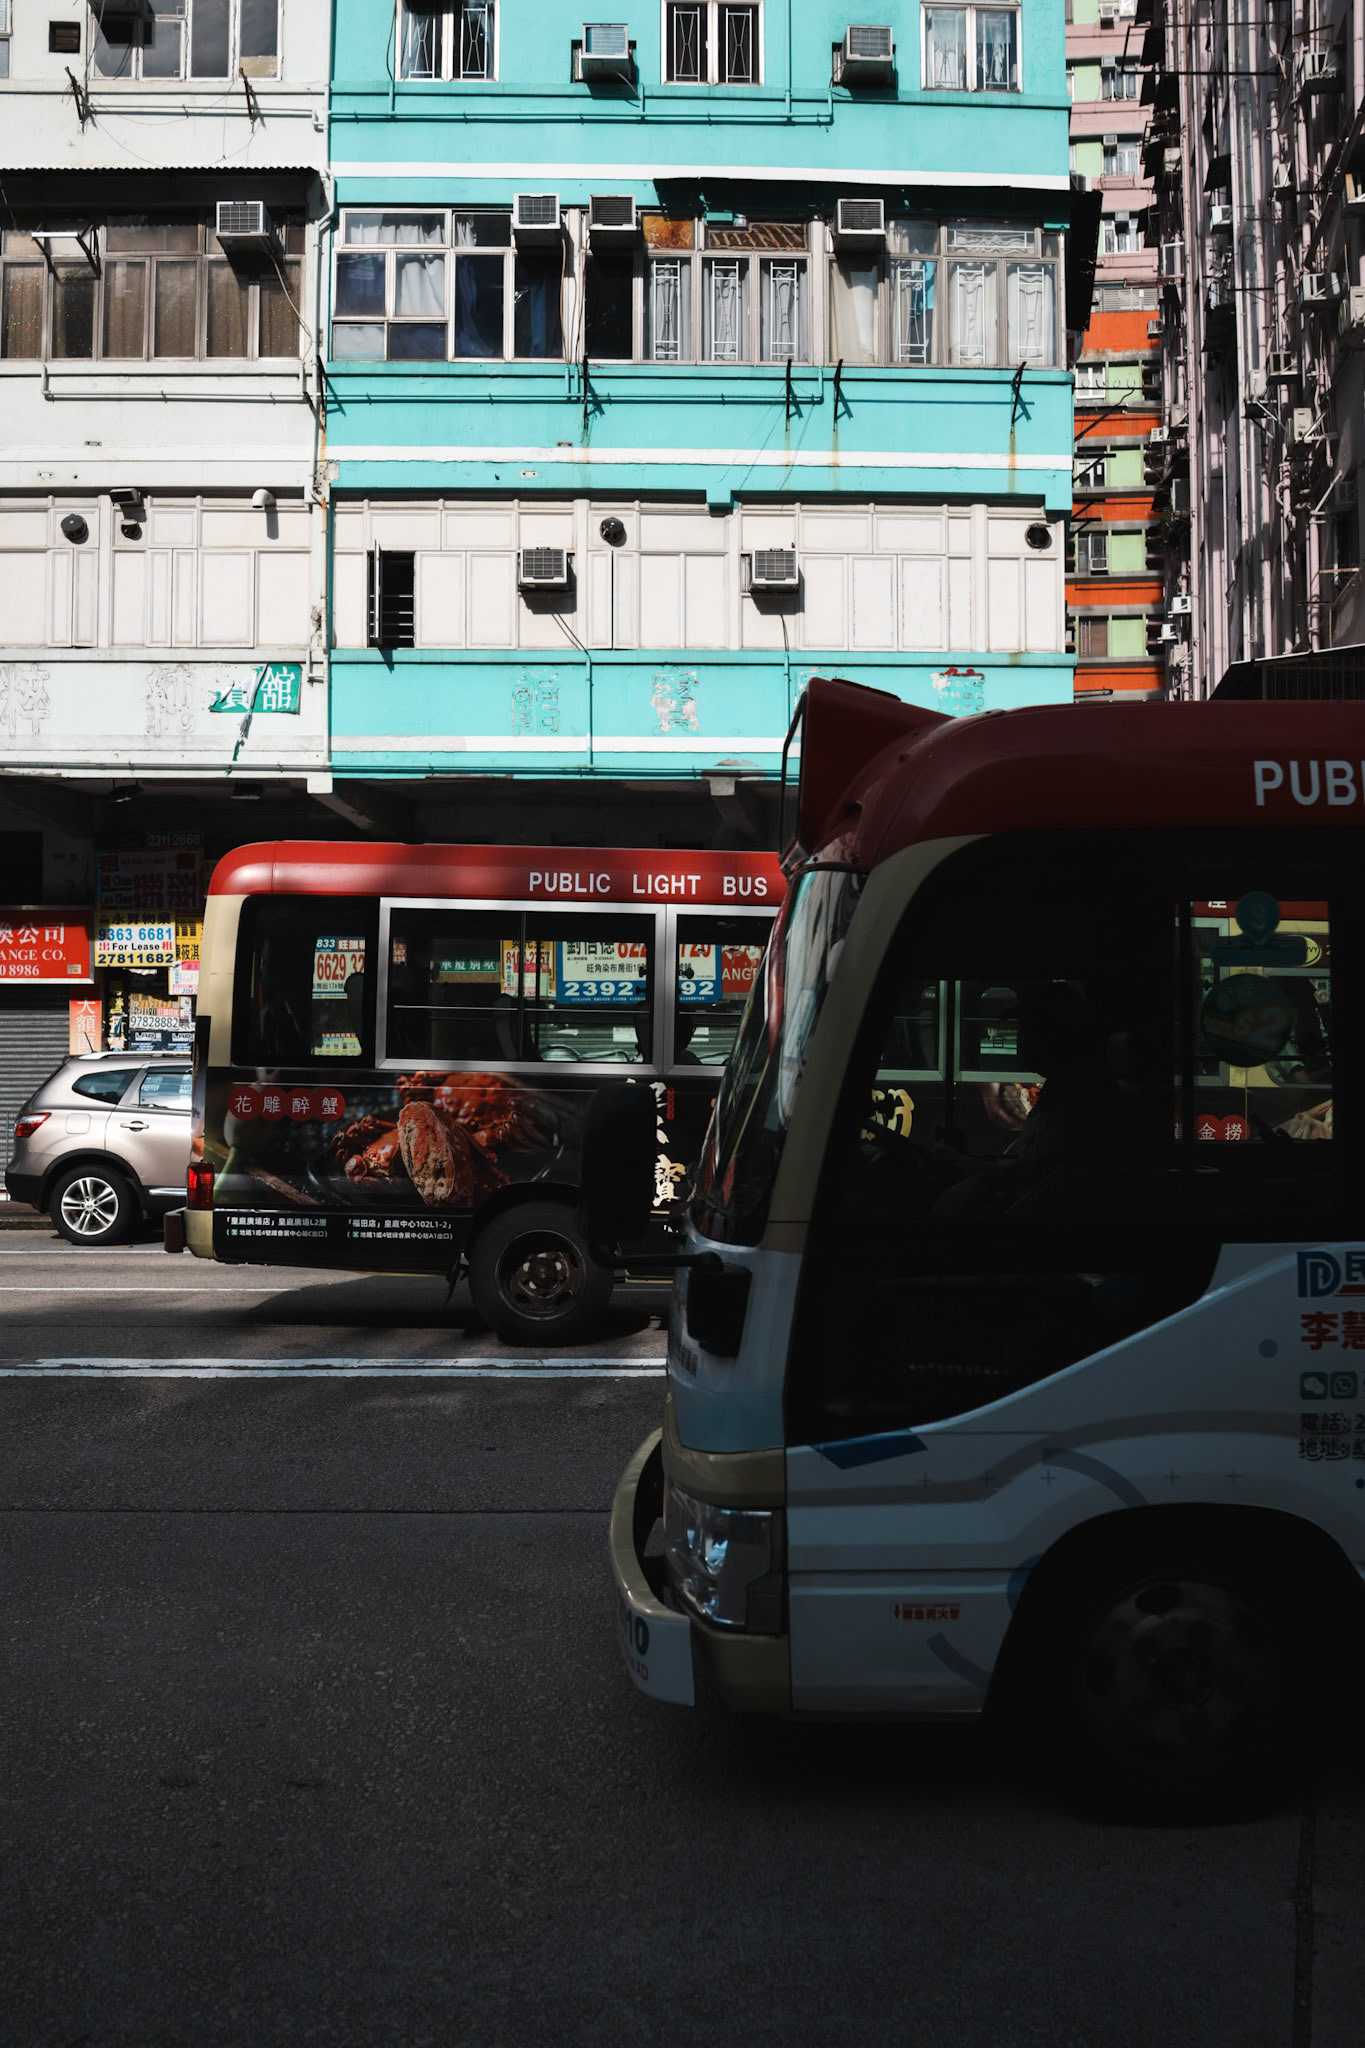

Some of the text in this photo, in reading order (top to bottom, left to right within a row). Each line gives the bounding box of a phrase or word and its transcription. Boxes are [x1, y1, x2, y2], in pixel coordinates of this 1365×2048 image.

[528, 872, 769, 897] PUBLIC LIGHT BUS
[98, 927, 133, 941] 9363
[138, 927, 172, 941] 6681
[99, 941, 173, 951] 出 For Lease 租
[41, 949, 67, 961] CO.
[98, 953, 175, 964] 27811682
[9, 964, 40, 976] 8986
[316, 953, 347, 981] 6629
[564, 981, 634, 997] 2392
[680, 981, 715, 996] 92
[130, 1016, 179, 1029] 97828882
[234, 1096, 339, 1116] 花雕醉蟹
